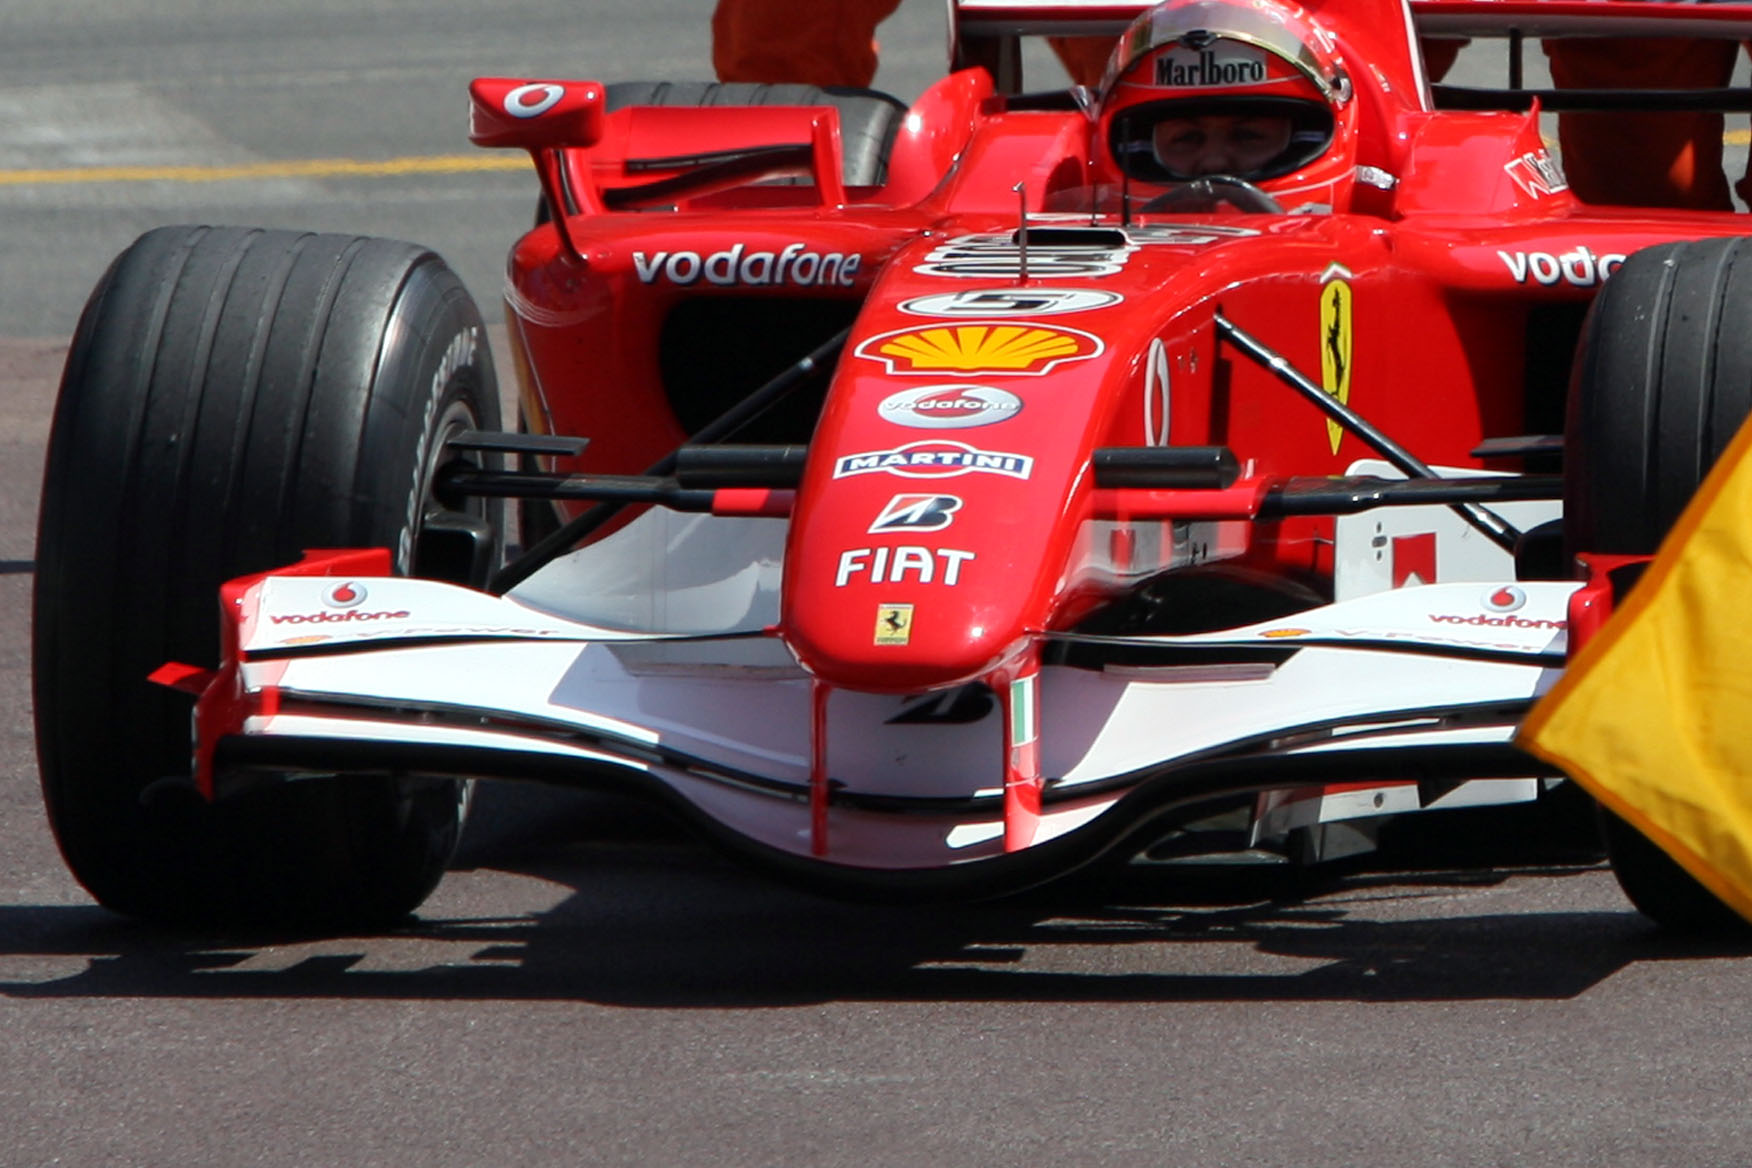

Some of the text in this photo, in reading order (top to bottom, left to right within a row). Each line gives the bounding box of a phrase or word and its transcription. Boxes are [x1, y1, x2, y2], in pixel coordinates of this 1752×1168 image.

[1155, 50, 1264, 86] Marlboro
[633, 243, 861, 288] vodafone
[886, 398, 1019, 412] vodafone
[847, 452, 1015, 471] MARTINI
[835, 545, 977, 587] FIAT
[270, 609, 410, 625] vodafone
